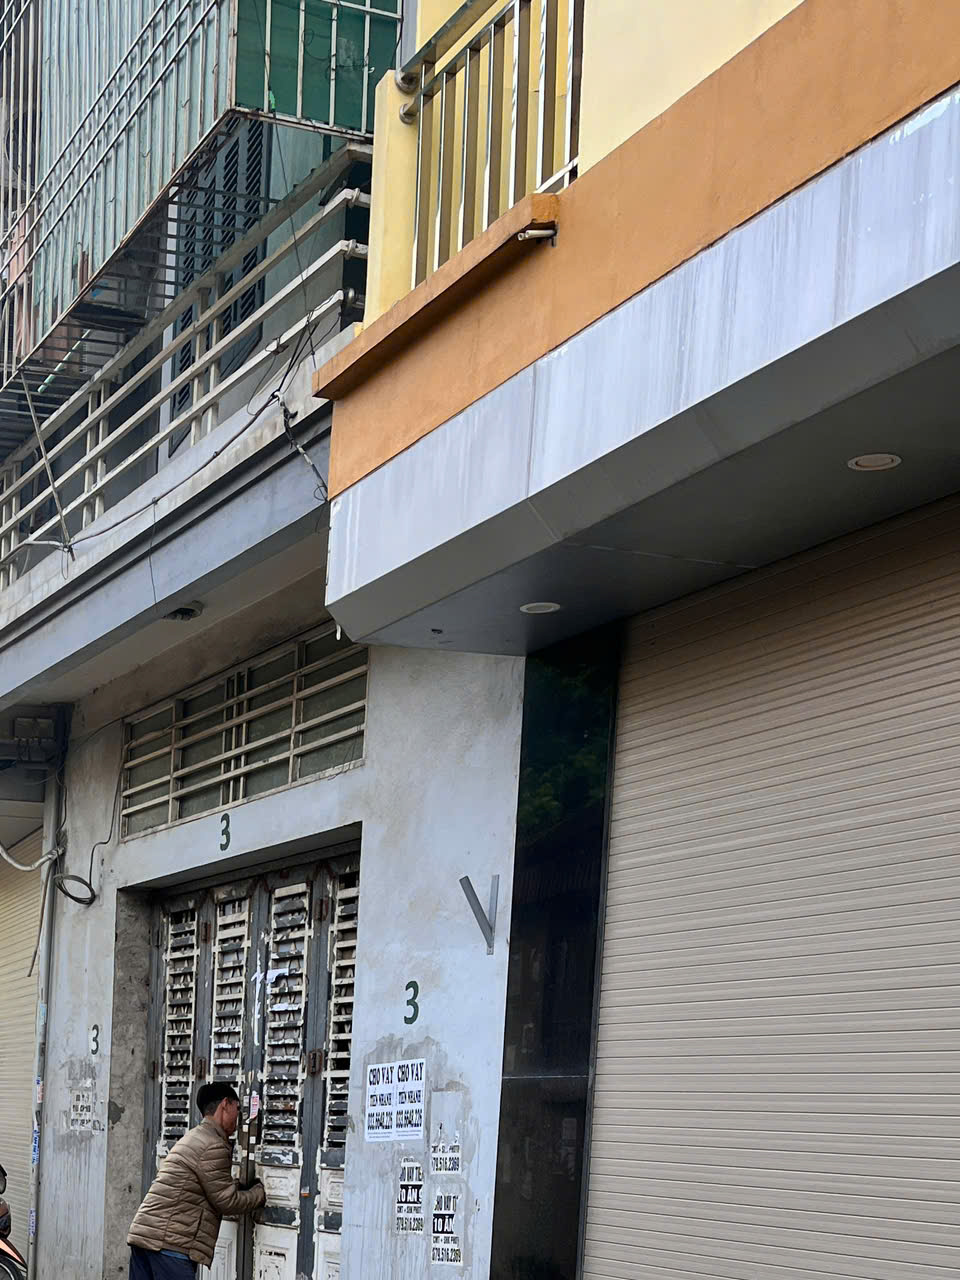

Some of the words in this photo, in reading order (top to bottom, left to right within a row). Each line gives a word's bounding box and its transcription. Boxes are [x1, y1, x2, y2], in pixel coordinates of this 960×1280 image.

[220, 813, 230, 851] 3
[404, 981, 419, 1024] 3
[91, 1024, 99, 1055] 3
[369, 1068, 380, 1086] CHO
[381, 1066, 394, 1084] VAY
[397, 1064, 409, 1083] CHO
[410, 1062, 424, 1081] VAY
[434, 1218, 442, 1232] 10
